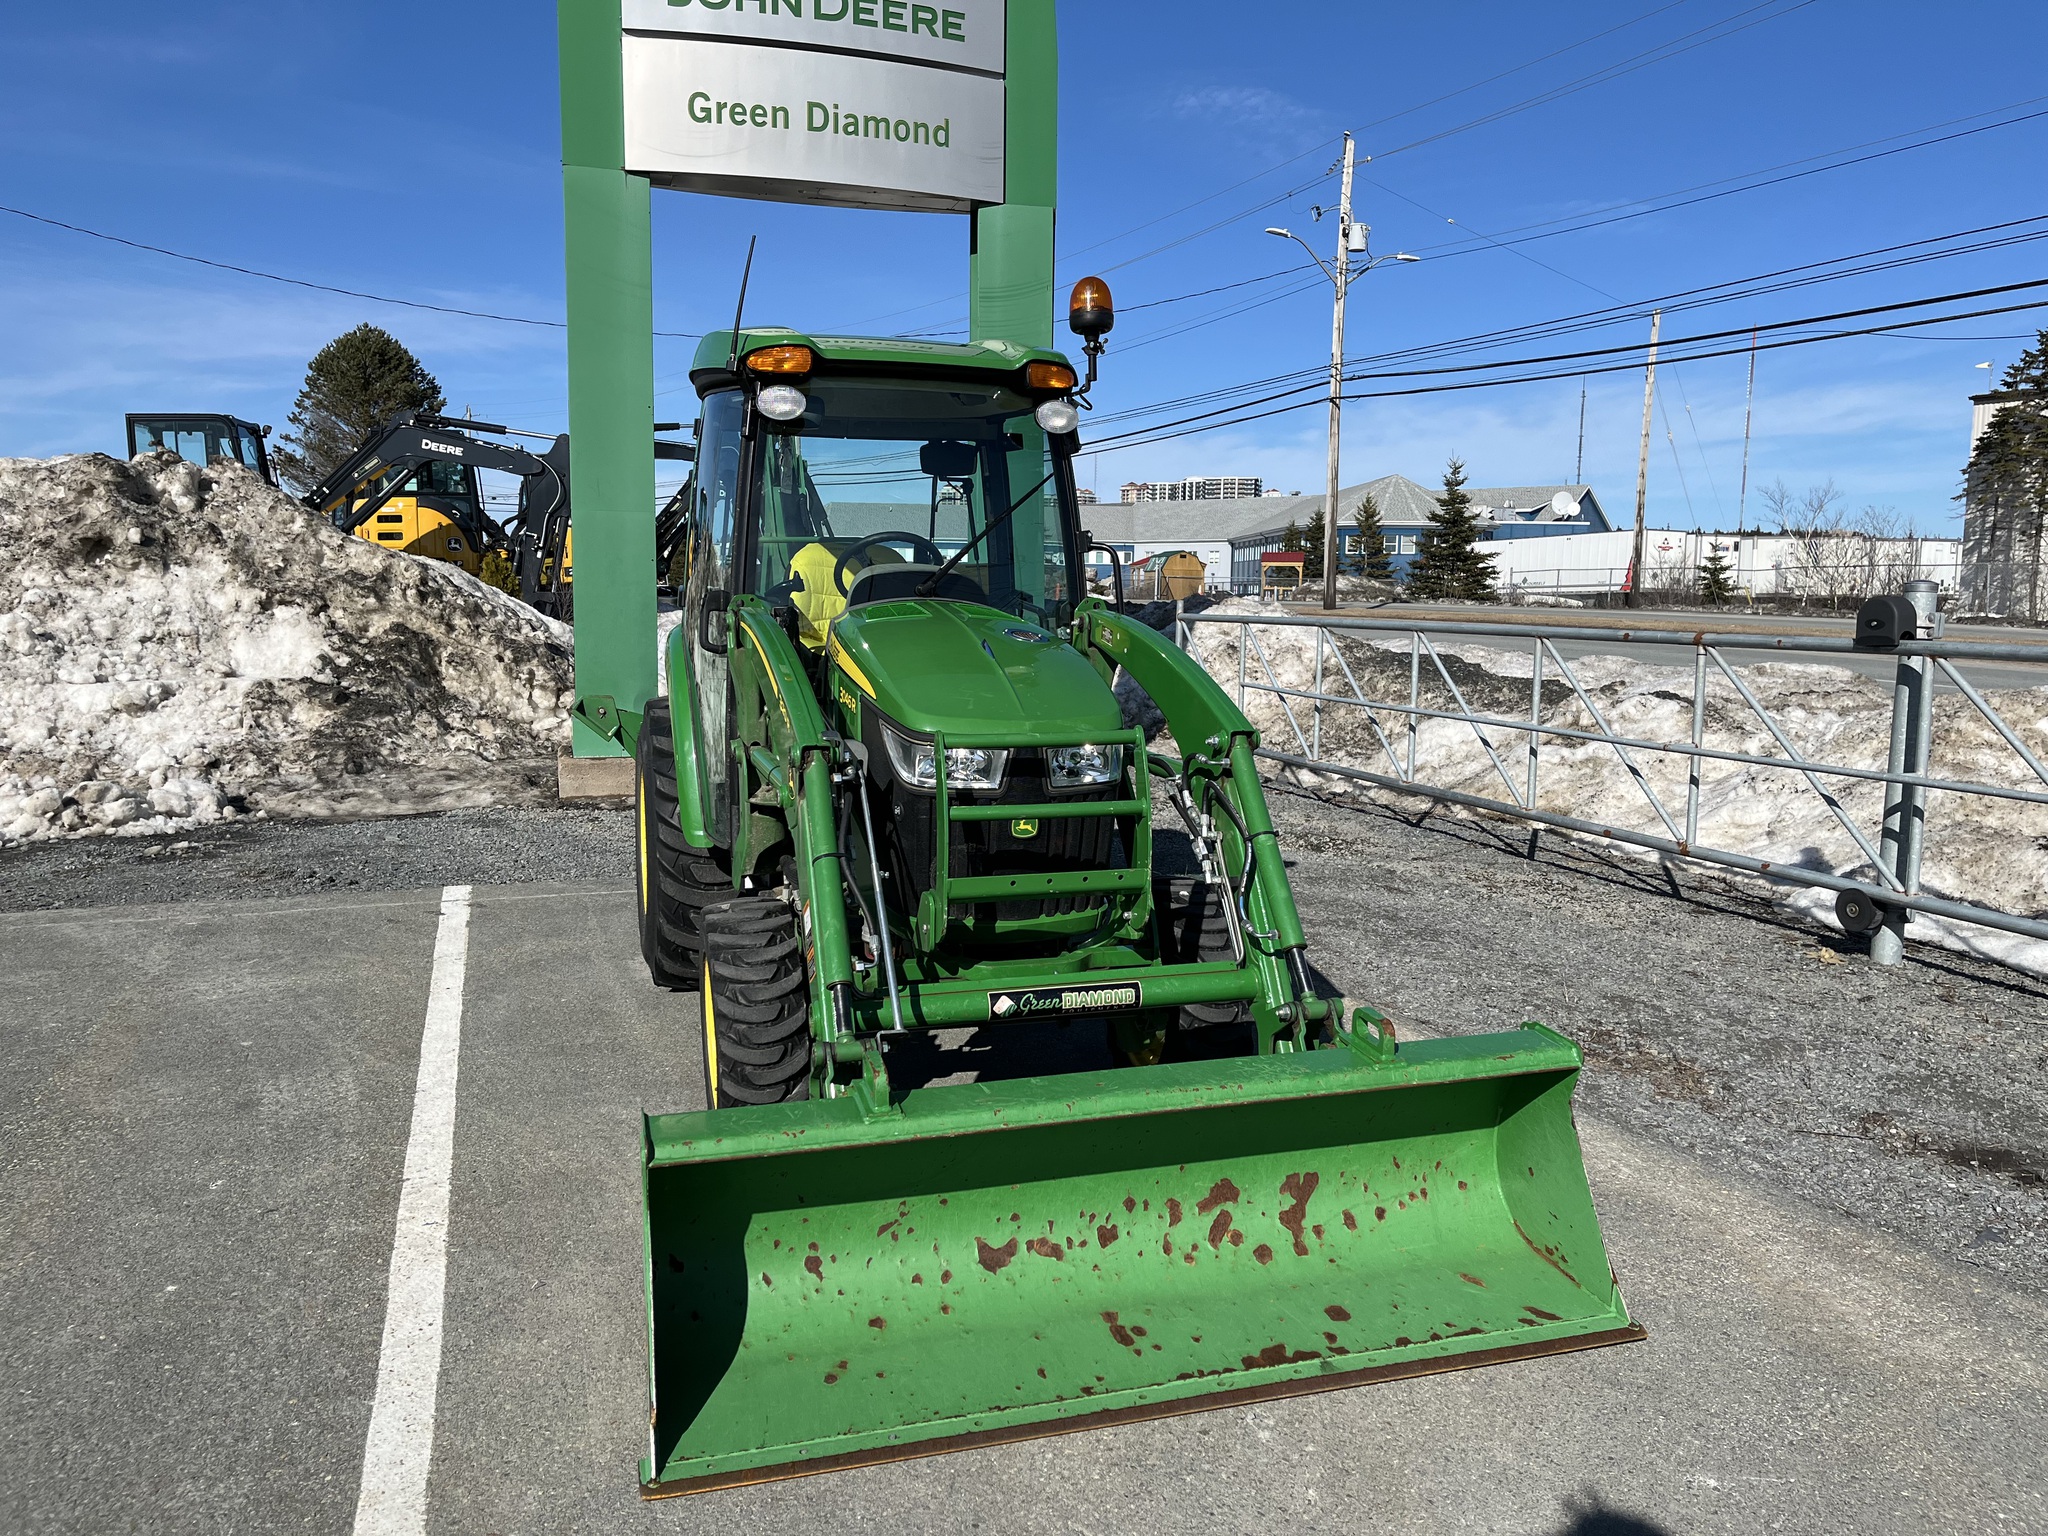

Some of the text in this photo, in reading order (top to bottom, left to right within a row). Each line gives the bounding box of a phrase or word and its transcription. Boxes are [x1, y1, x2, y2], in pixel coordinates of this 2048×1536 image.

[814, 0, 966, 43] DEERE
[688, 91, 950, 148] Green Diamond
[421, 438, 464, 456] DEERE
[1019, 988, 1136, 1016] Green DIAMOND
